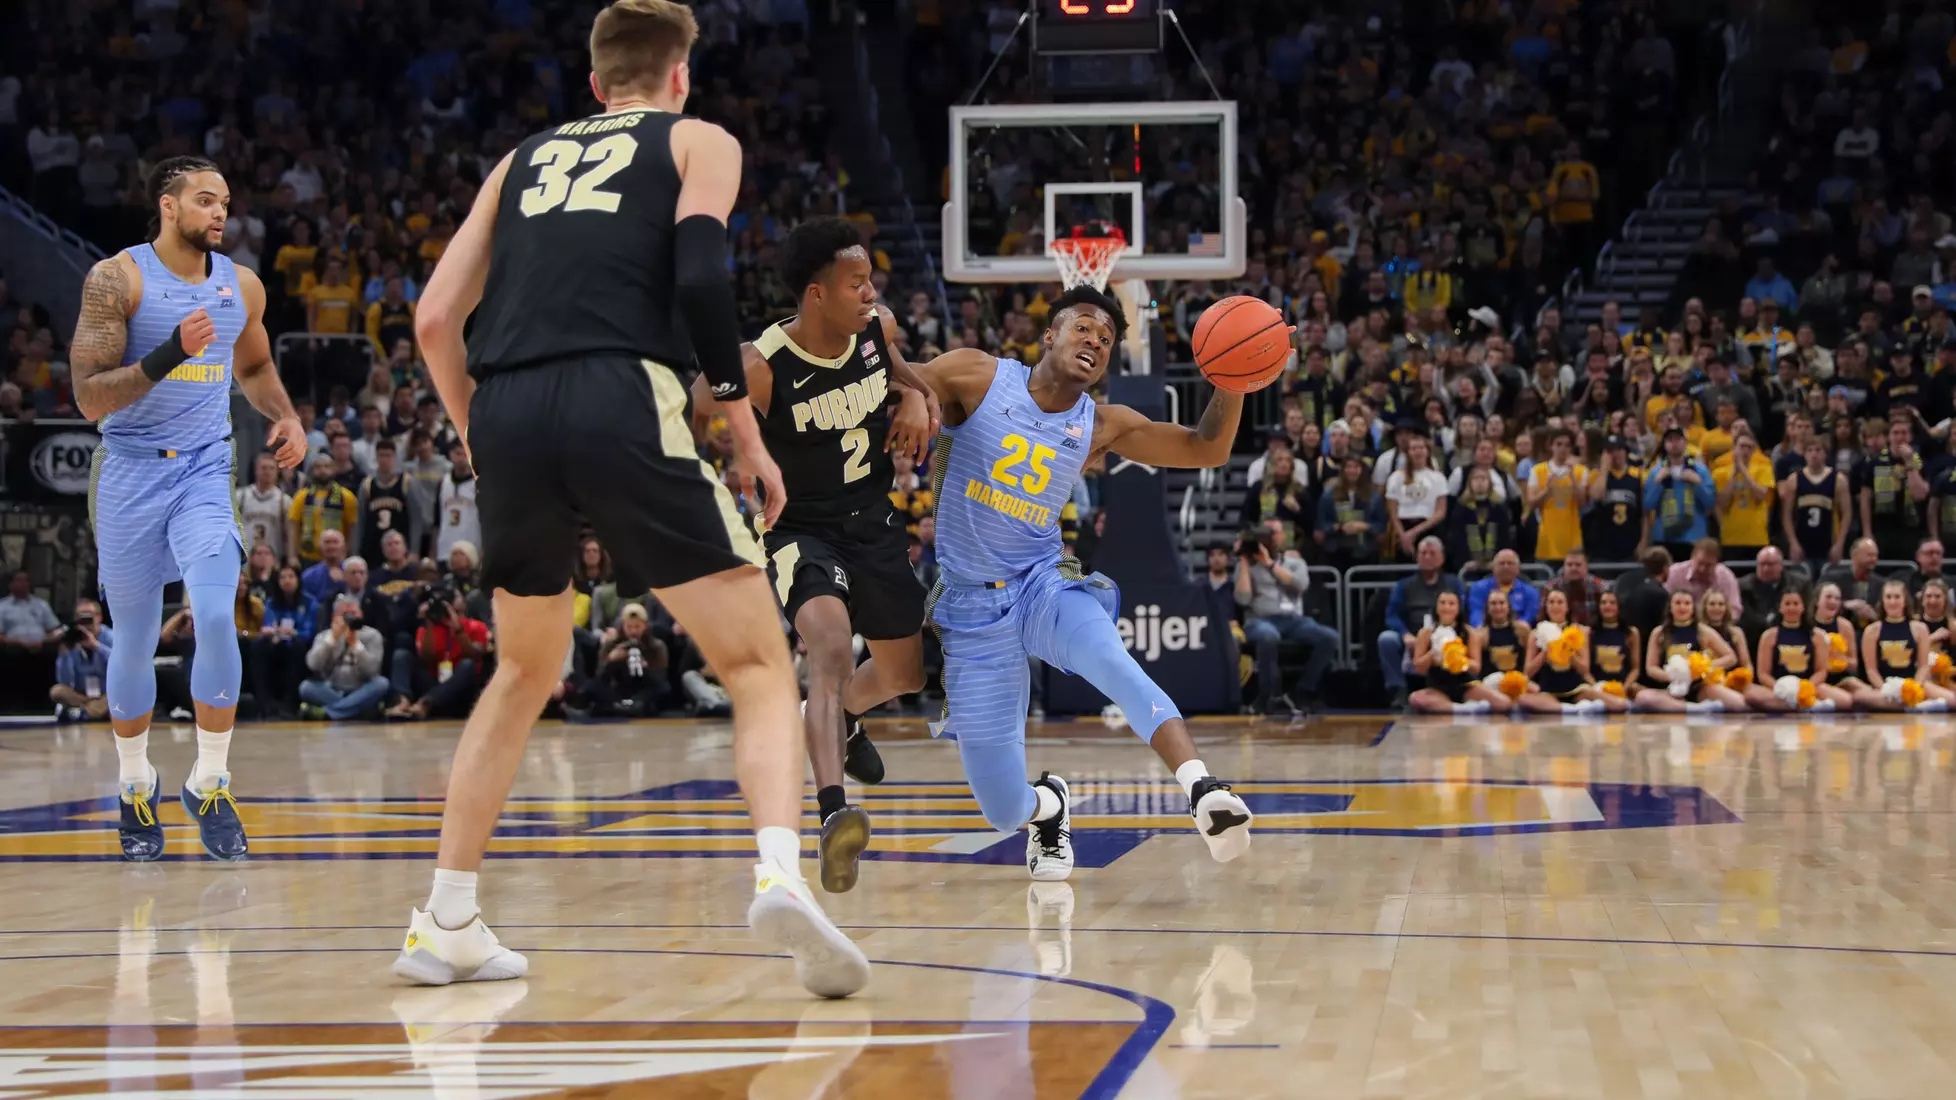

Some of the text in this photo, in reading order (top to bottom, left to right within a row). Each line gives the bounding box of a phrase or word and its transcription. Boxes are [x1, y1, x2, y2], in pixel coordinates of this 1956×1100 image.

[554, 113, 645, 136] HAARMS
[520, 133, 639, 218] 32
[791, 367, 888, 432] PURDUE
[52, 445, 94, 471] FO
[840, 427, 871, 484] 2
[990, 433, 1057, 496] 25
[964, 478, 1052, 528] MARQUETTE
[1807, 507, 1821, 528] 3
[1116, 603, 1208, 662] eijer
